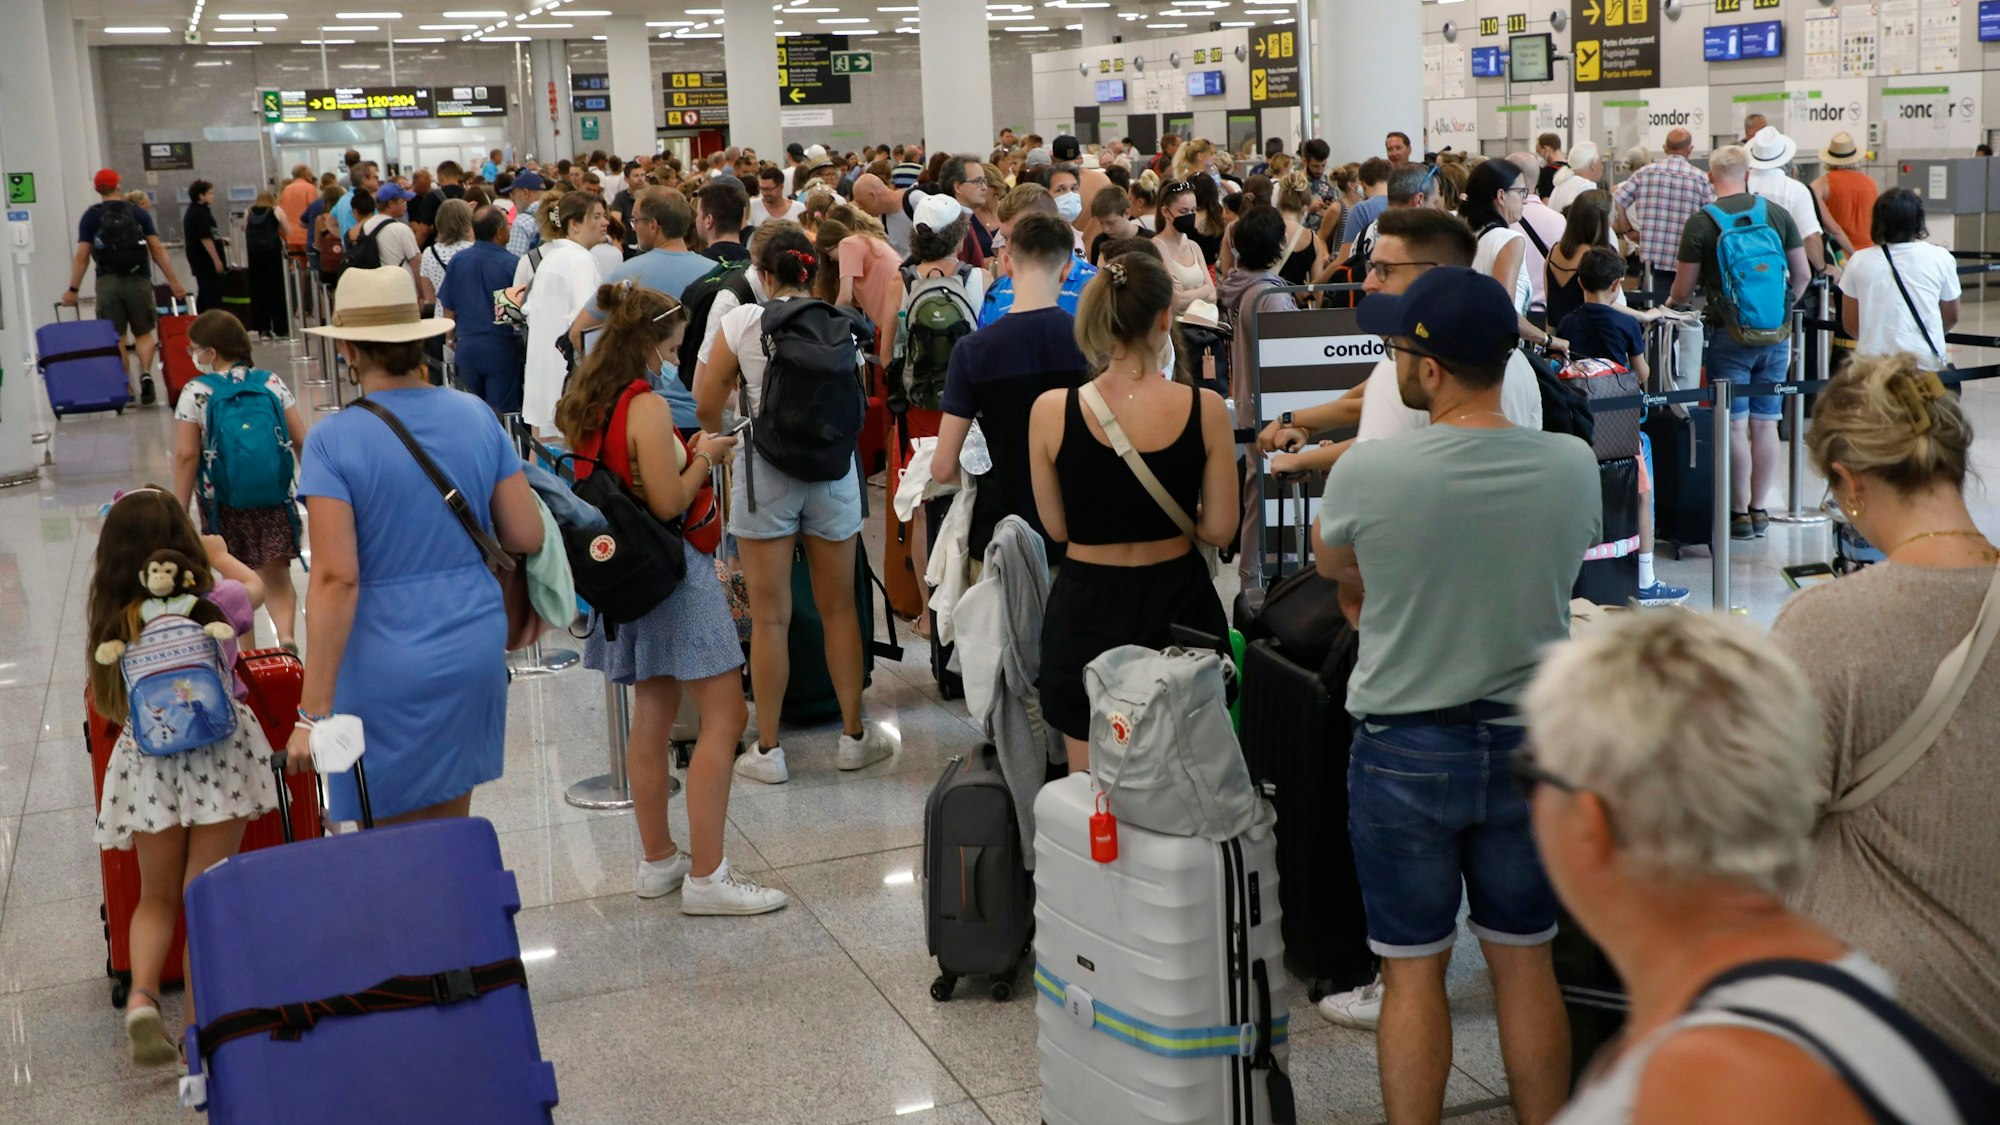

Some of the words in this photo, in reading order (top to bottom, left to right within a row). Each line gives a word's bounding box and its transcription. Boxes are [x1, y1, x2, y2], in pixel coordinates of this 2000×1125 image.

[1481, 18, 1498, 34] 110
[1508, 15, 1525, 31] 111
[1323, 340, 1384, 357] condo
